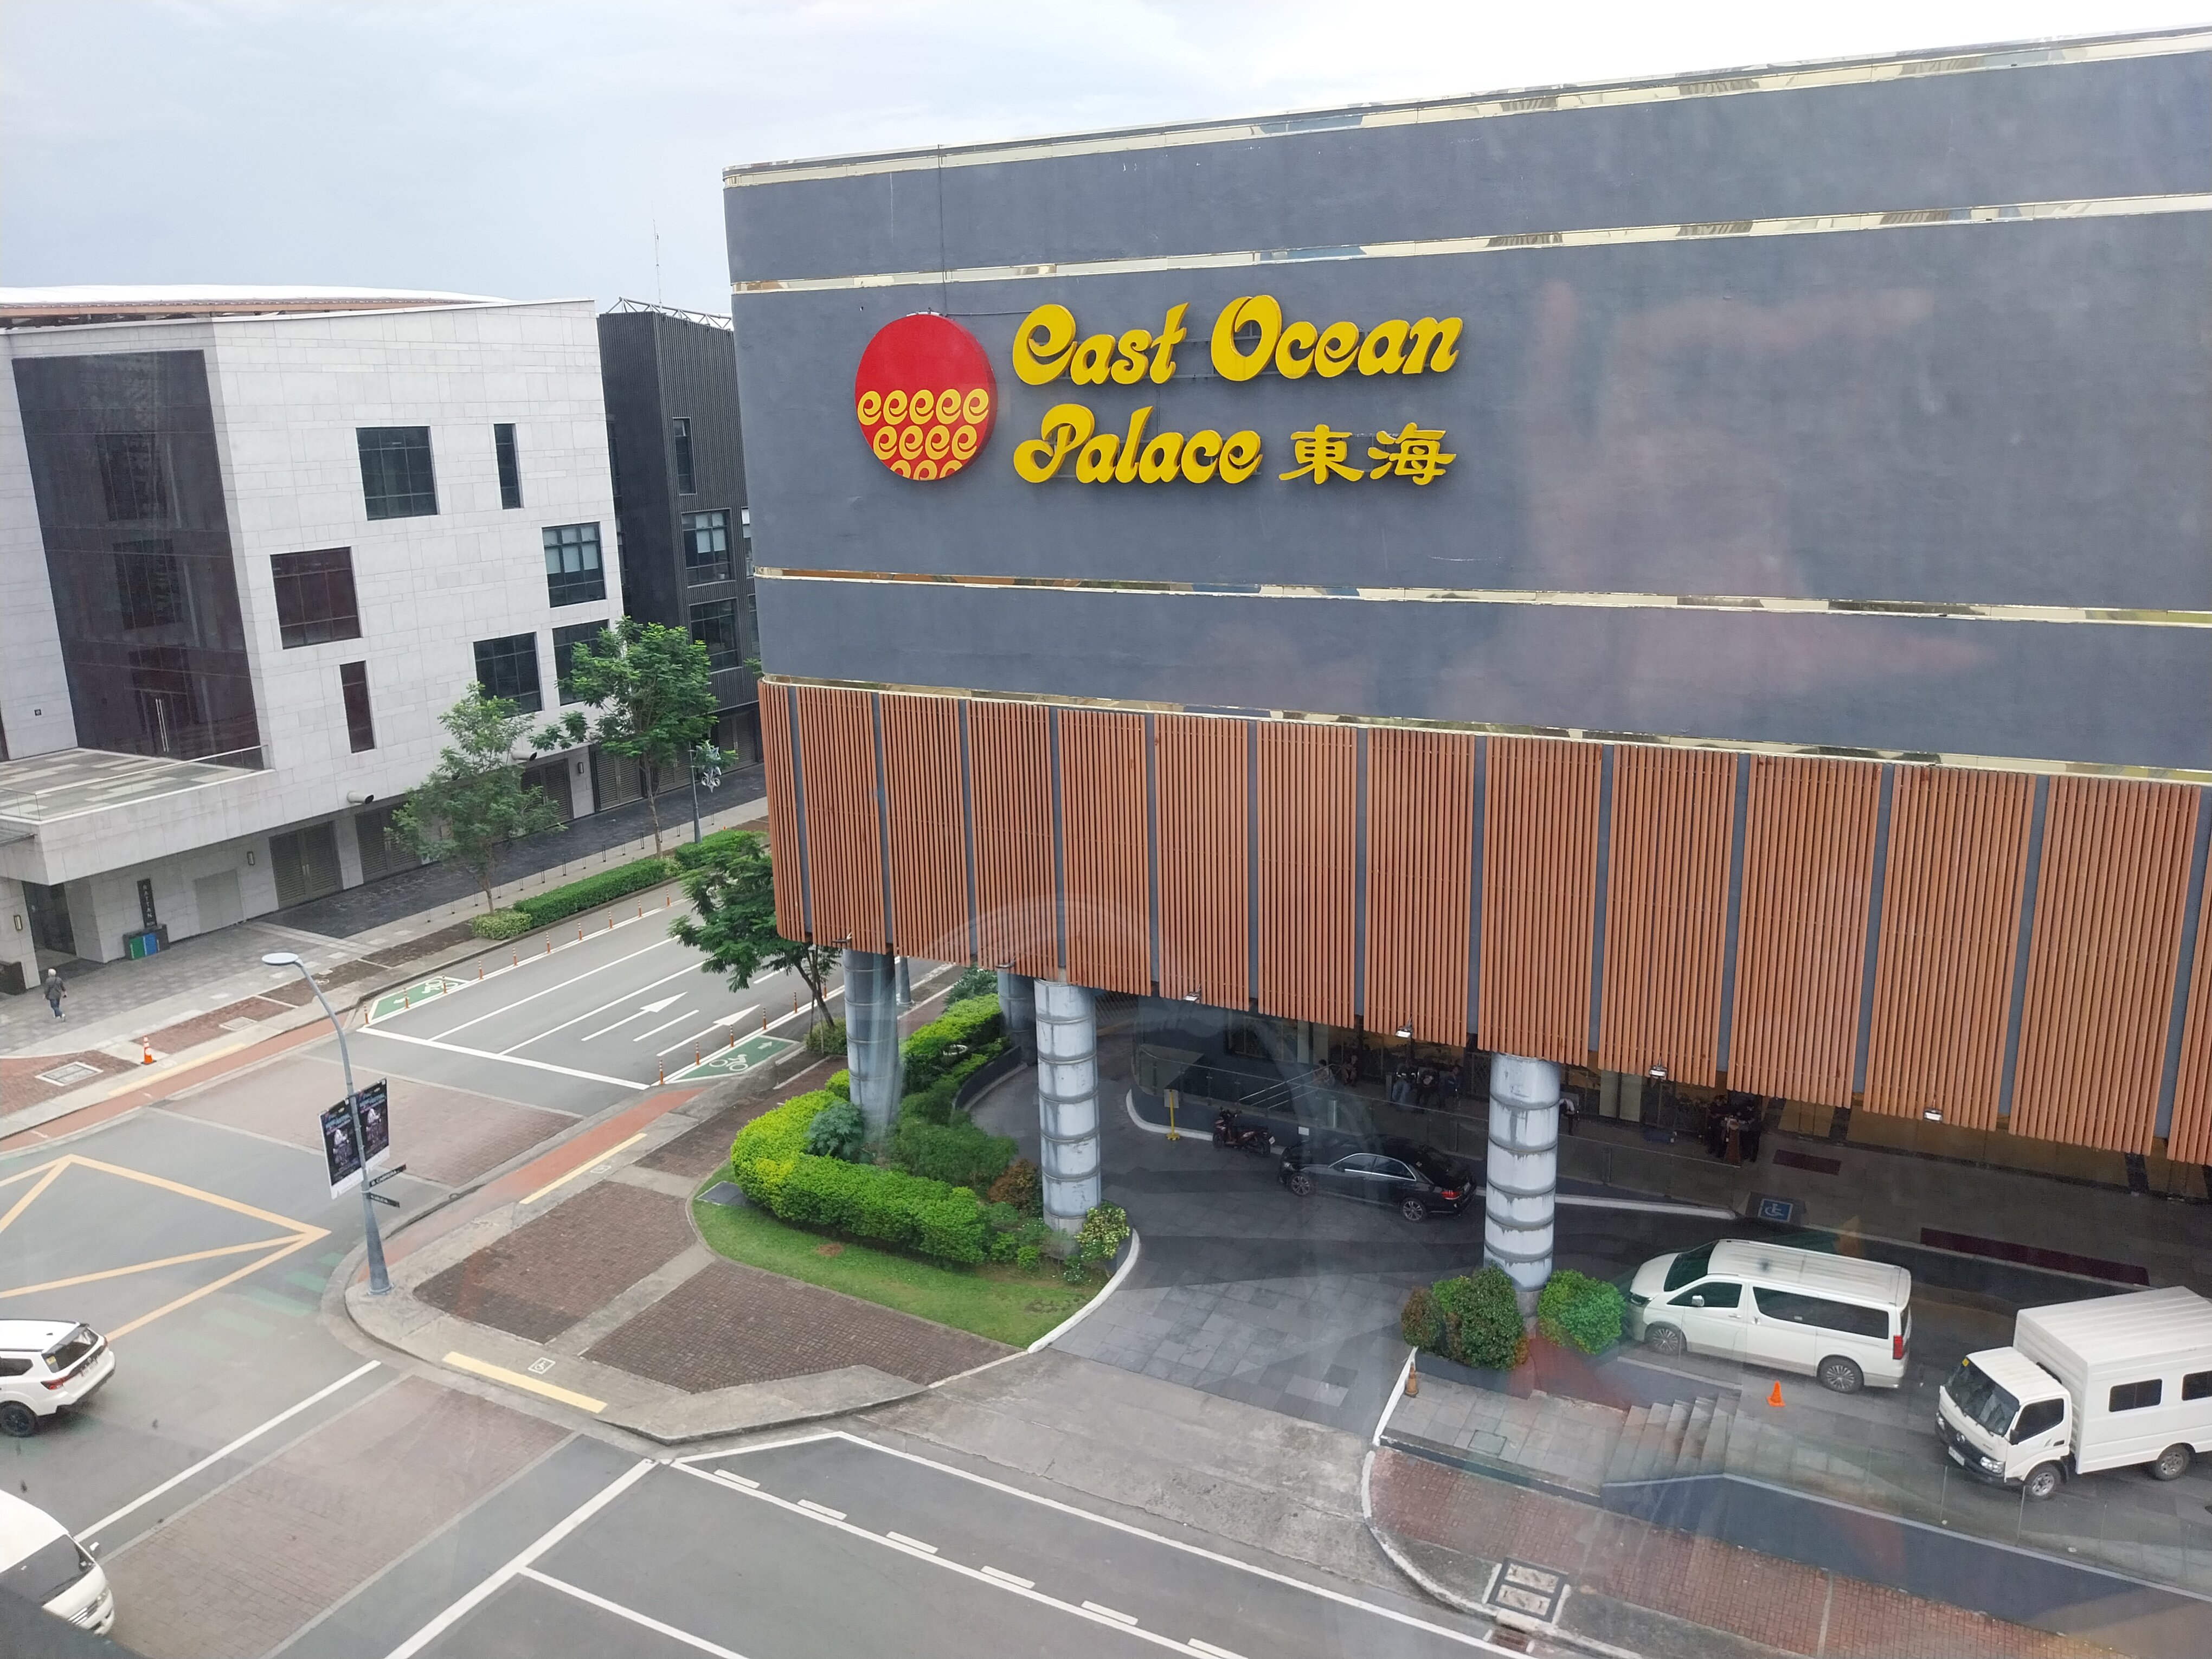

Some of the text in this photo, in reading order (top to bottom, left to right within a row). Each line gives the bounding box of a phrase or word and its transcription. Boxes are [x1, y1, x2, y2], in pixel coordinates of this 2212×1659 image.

[1210, 294, 1463, 382] Ocean
[1012, 402, 1263, 485] Palace
[1278, 422, 1456, 486] 東海
